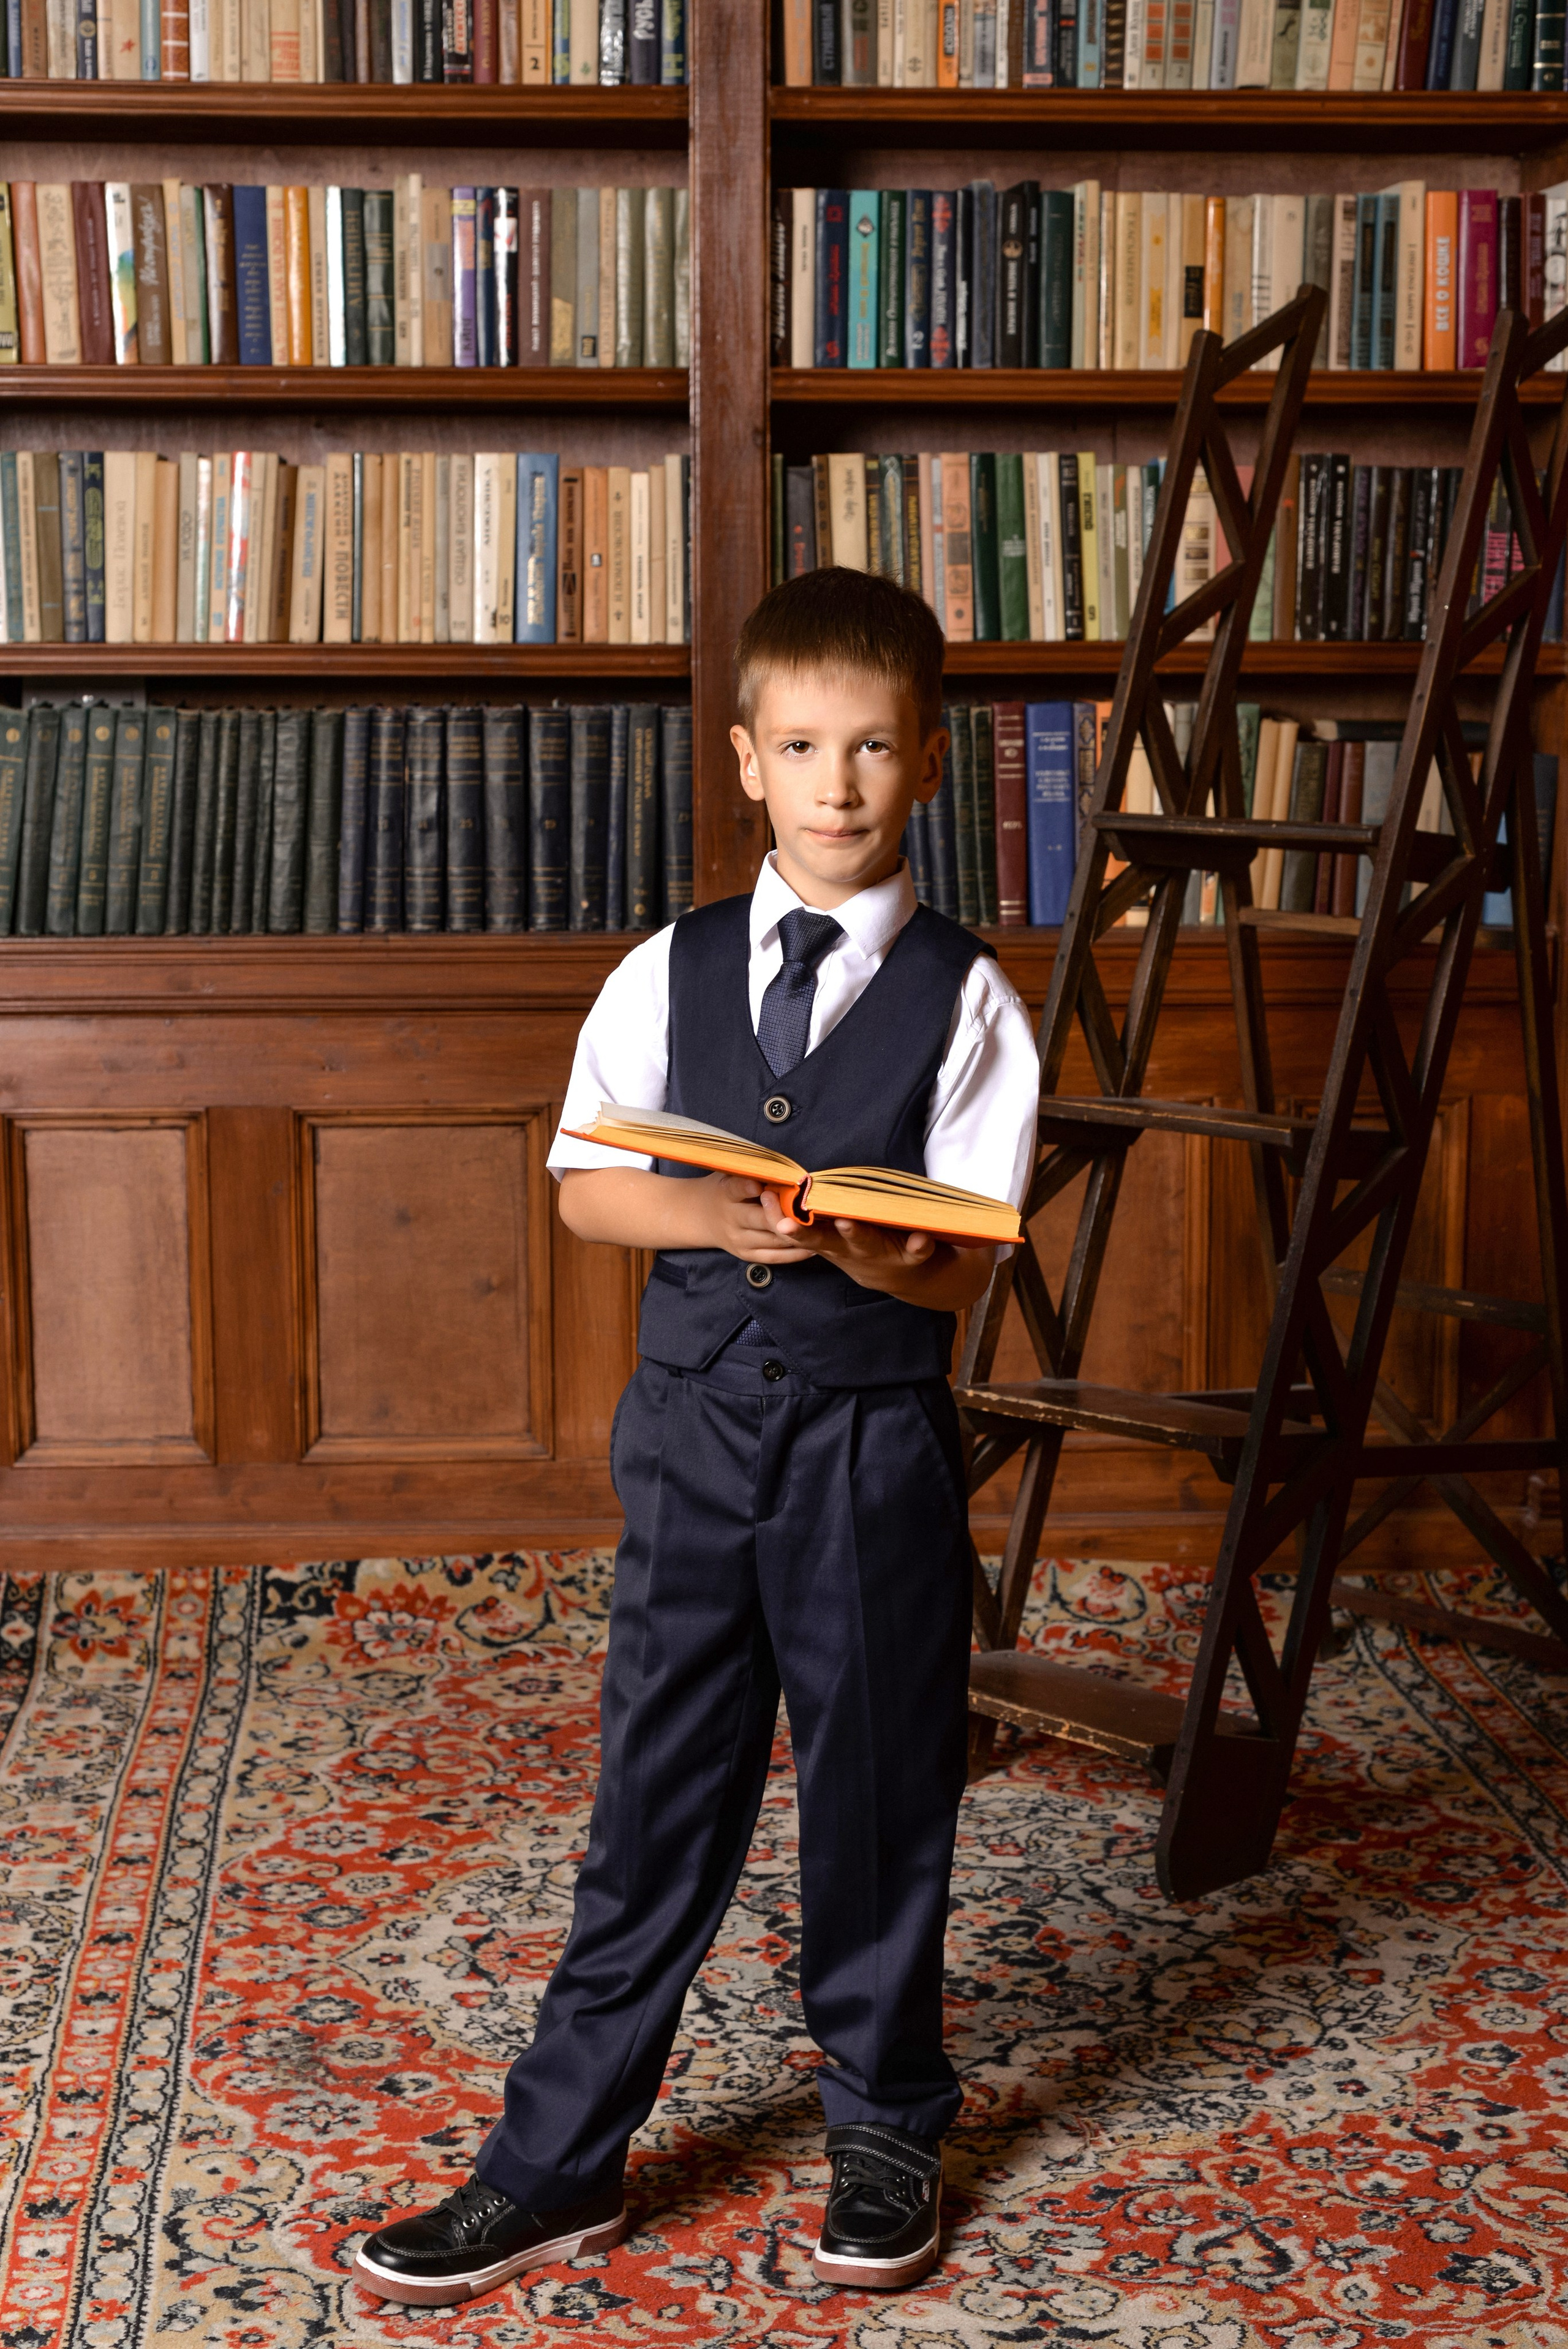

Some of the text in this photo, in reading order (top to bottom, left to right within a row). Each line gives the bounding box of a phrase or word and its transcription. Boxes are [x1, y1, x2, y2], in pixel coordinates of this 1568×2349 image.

[530, 57, 540, 70] 2
[1436, 236, 1450, 333] ВСЕ О КОШКЕ
[112, 500, 129, 609] Борис Полевой
[455, 464, 467, 586] ОБЩАЯ БИОЛОГИЯ
[335, 551, 350, 620] ПОВЕСТИ
